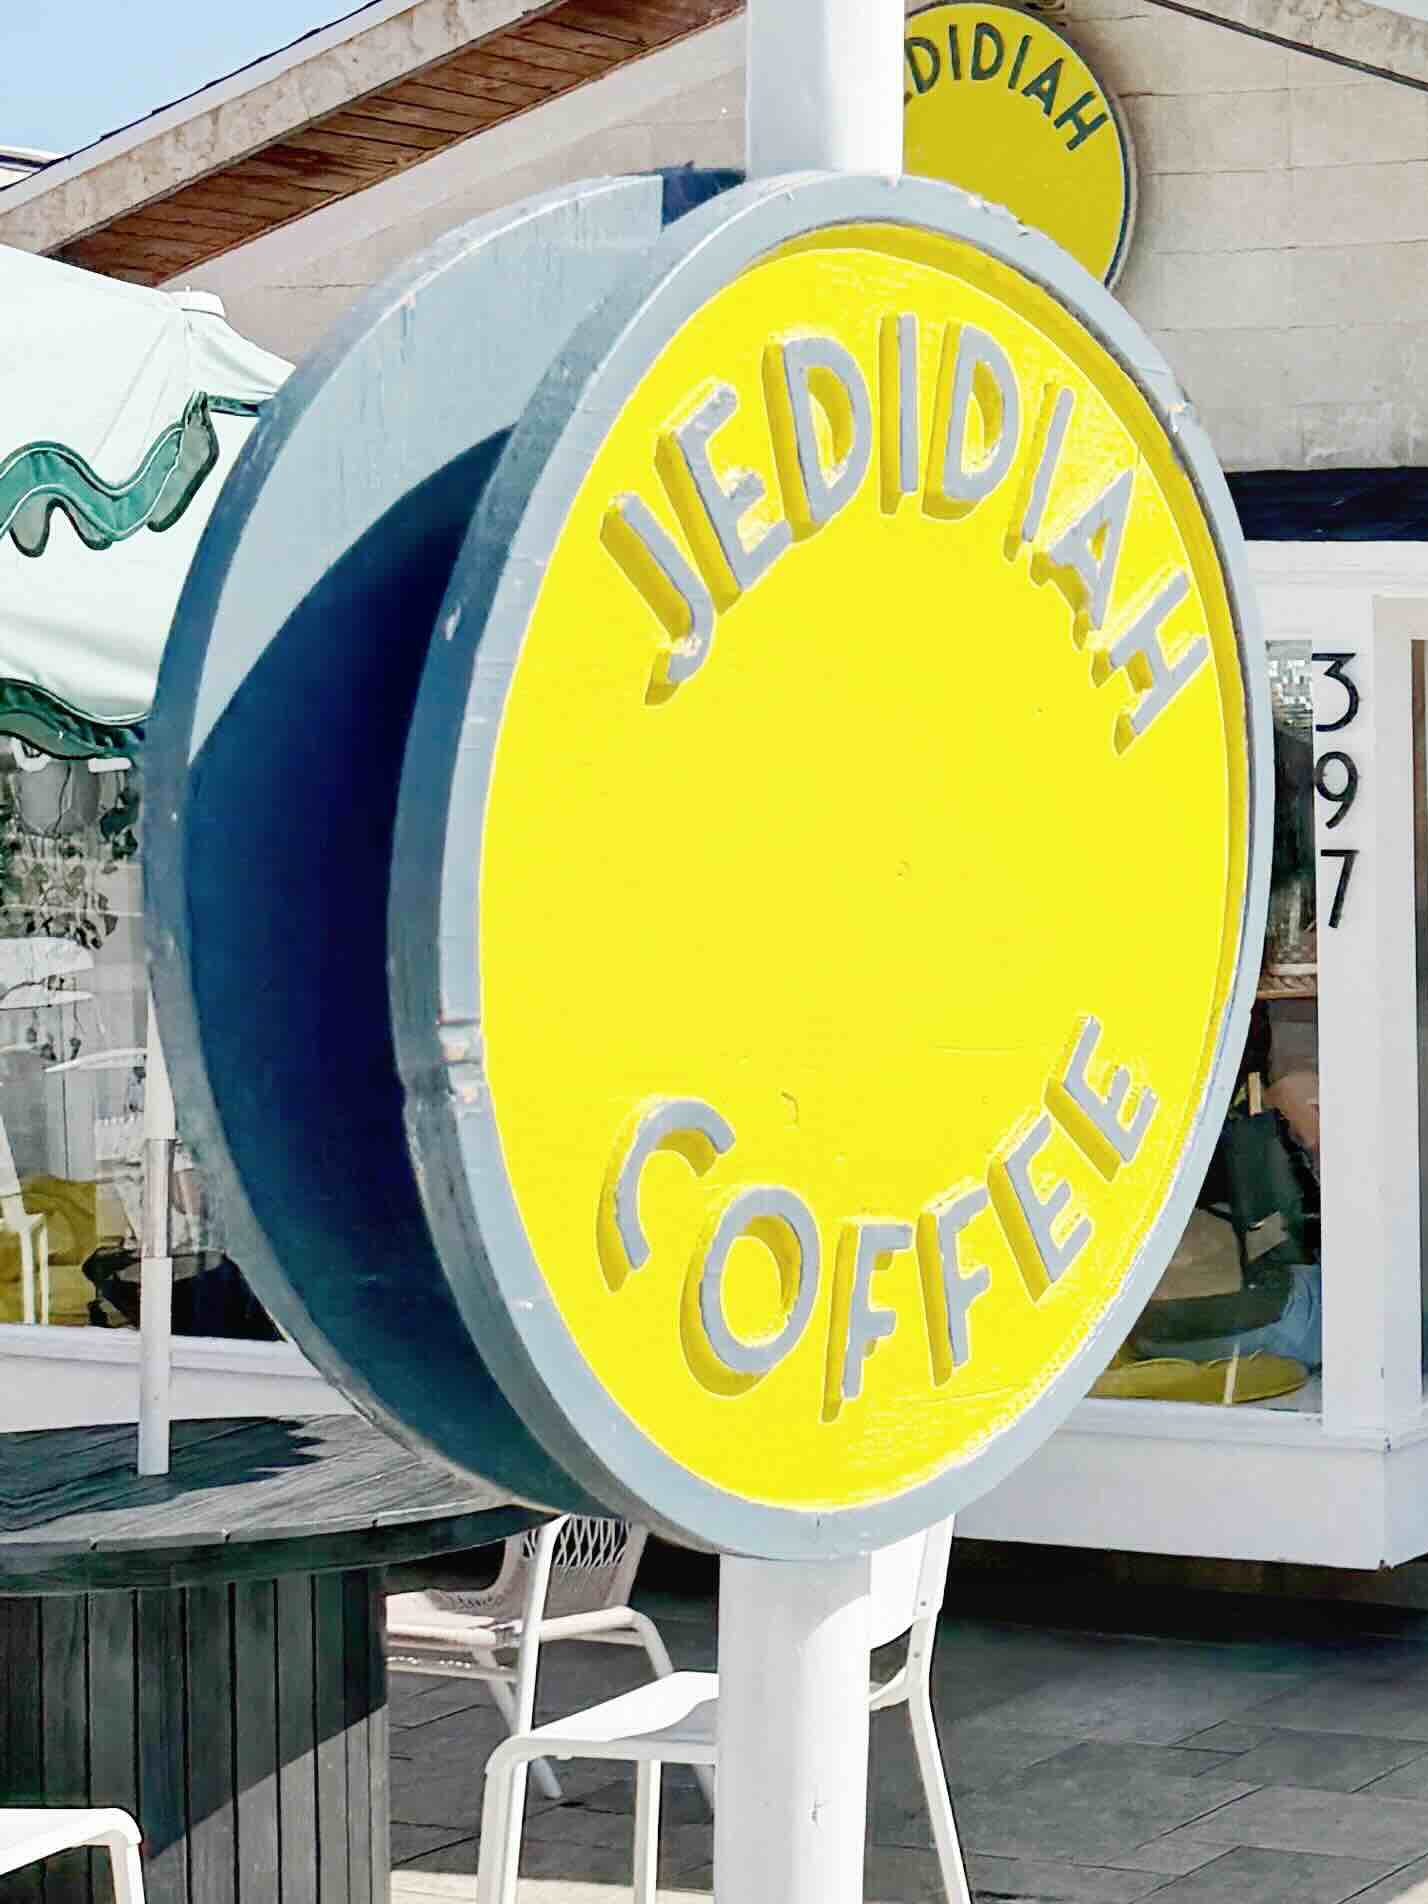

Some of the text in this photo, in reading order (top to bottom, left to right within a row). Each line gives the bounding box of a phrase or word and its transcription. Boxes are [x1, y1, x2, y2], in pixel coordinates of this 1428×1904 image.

[903, 21, 1108, 151] DIDIAH
[602, 311, 1211, 753] JEDIDIAH
[1312, 651, 1361, 930] 397
[598, 1014, 1159, 1424] COFFEE
